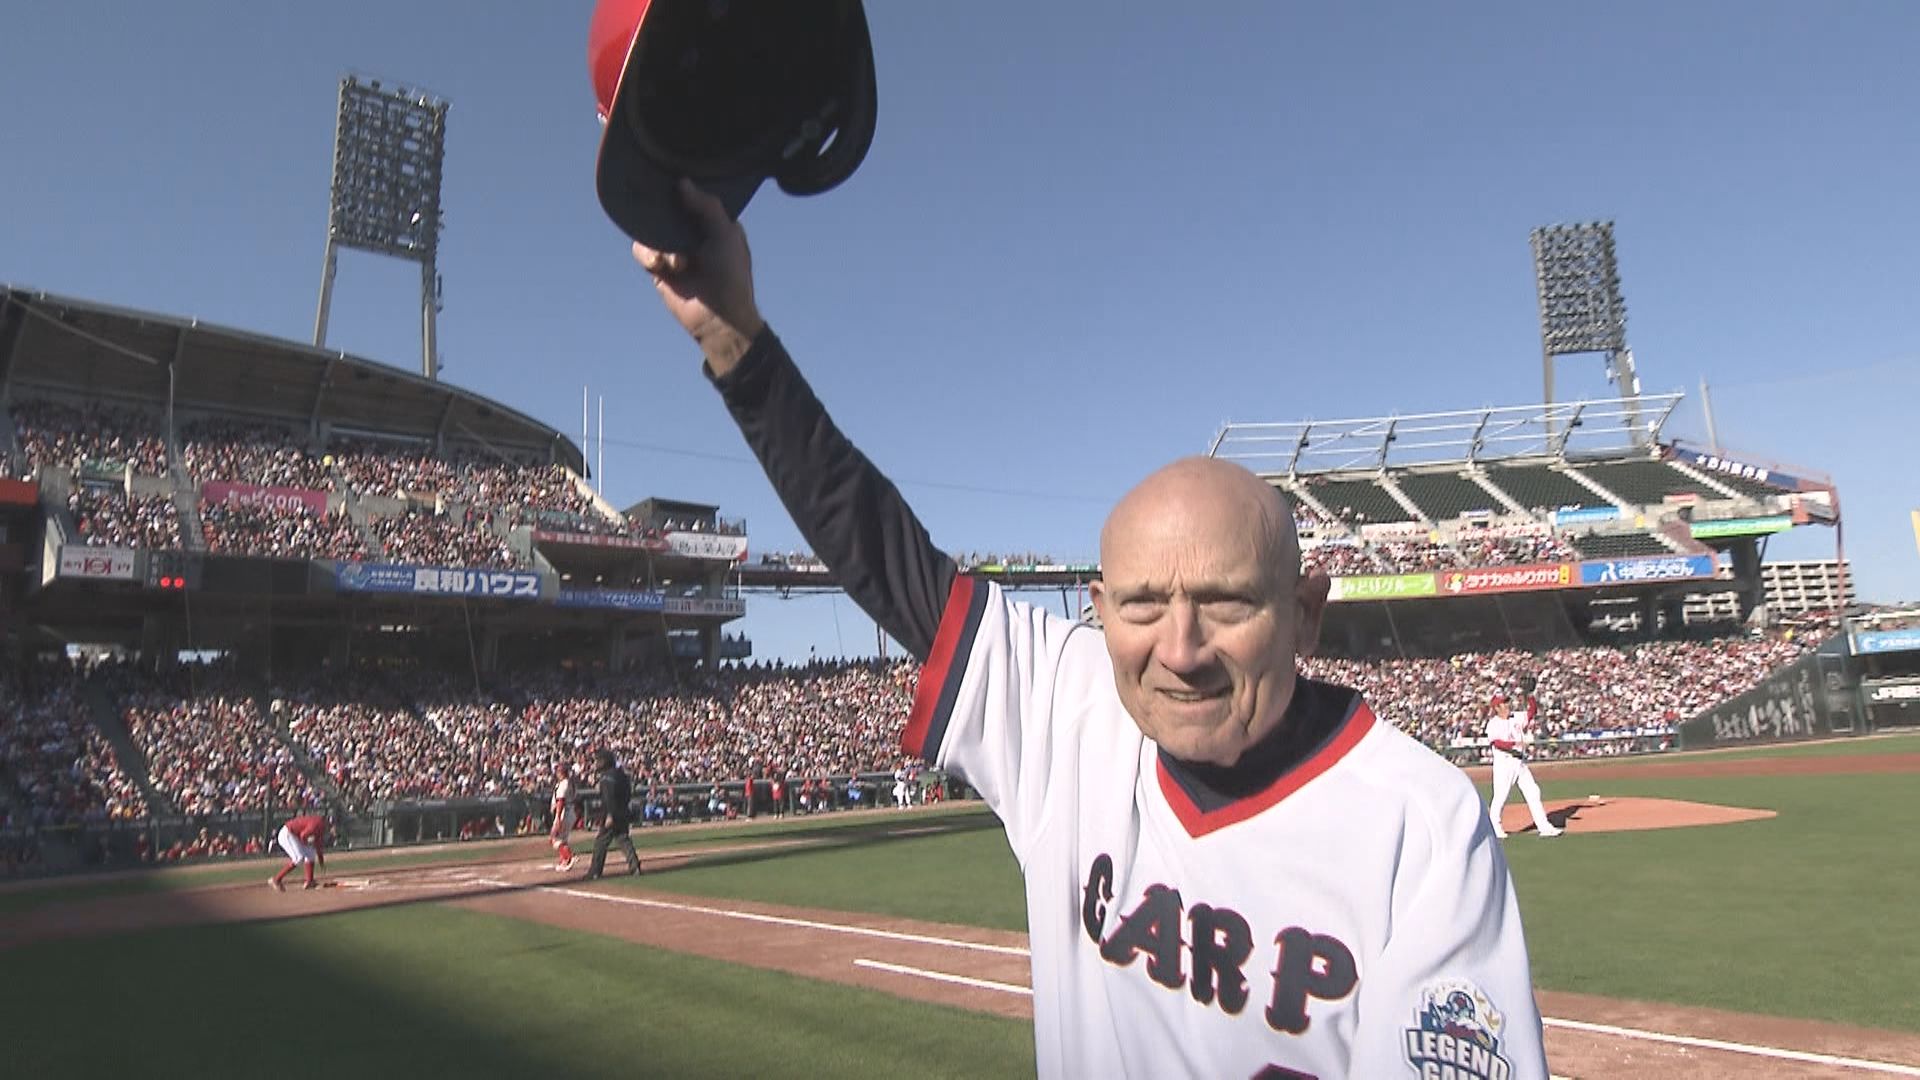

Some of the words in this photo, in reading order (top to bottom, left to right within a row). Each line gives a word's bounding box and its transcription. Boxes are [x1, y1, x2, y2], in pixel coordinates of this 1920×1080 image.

[414, 568, 538, 596] 良和ハウス
[1466, 568, 1560, 589] タナカのふりかけ
[1082, 853, 1359, 1035] CARP
[1408, 1030, 1509, 1080] LEGEND
